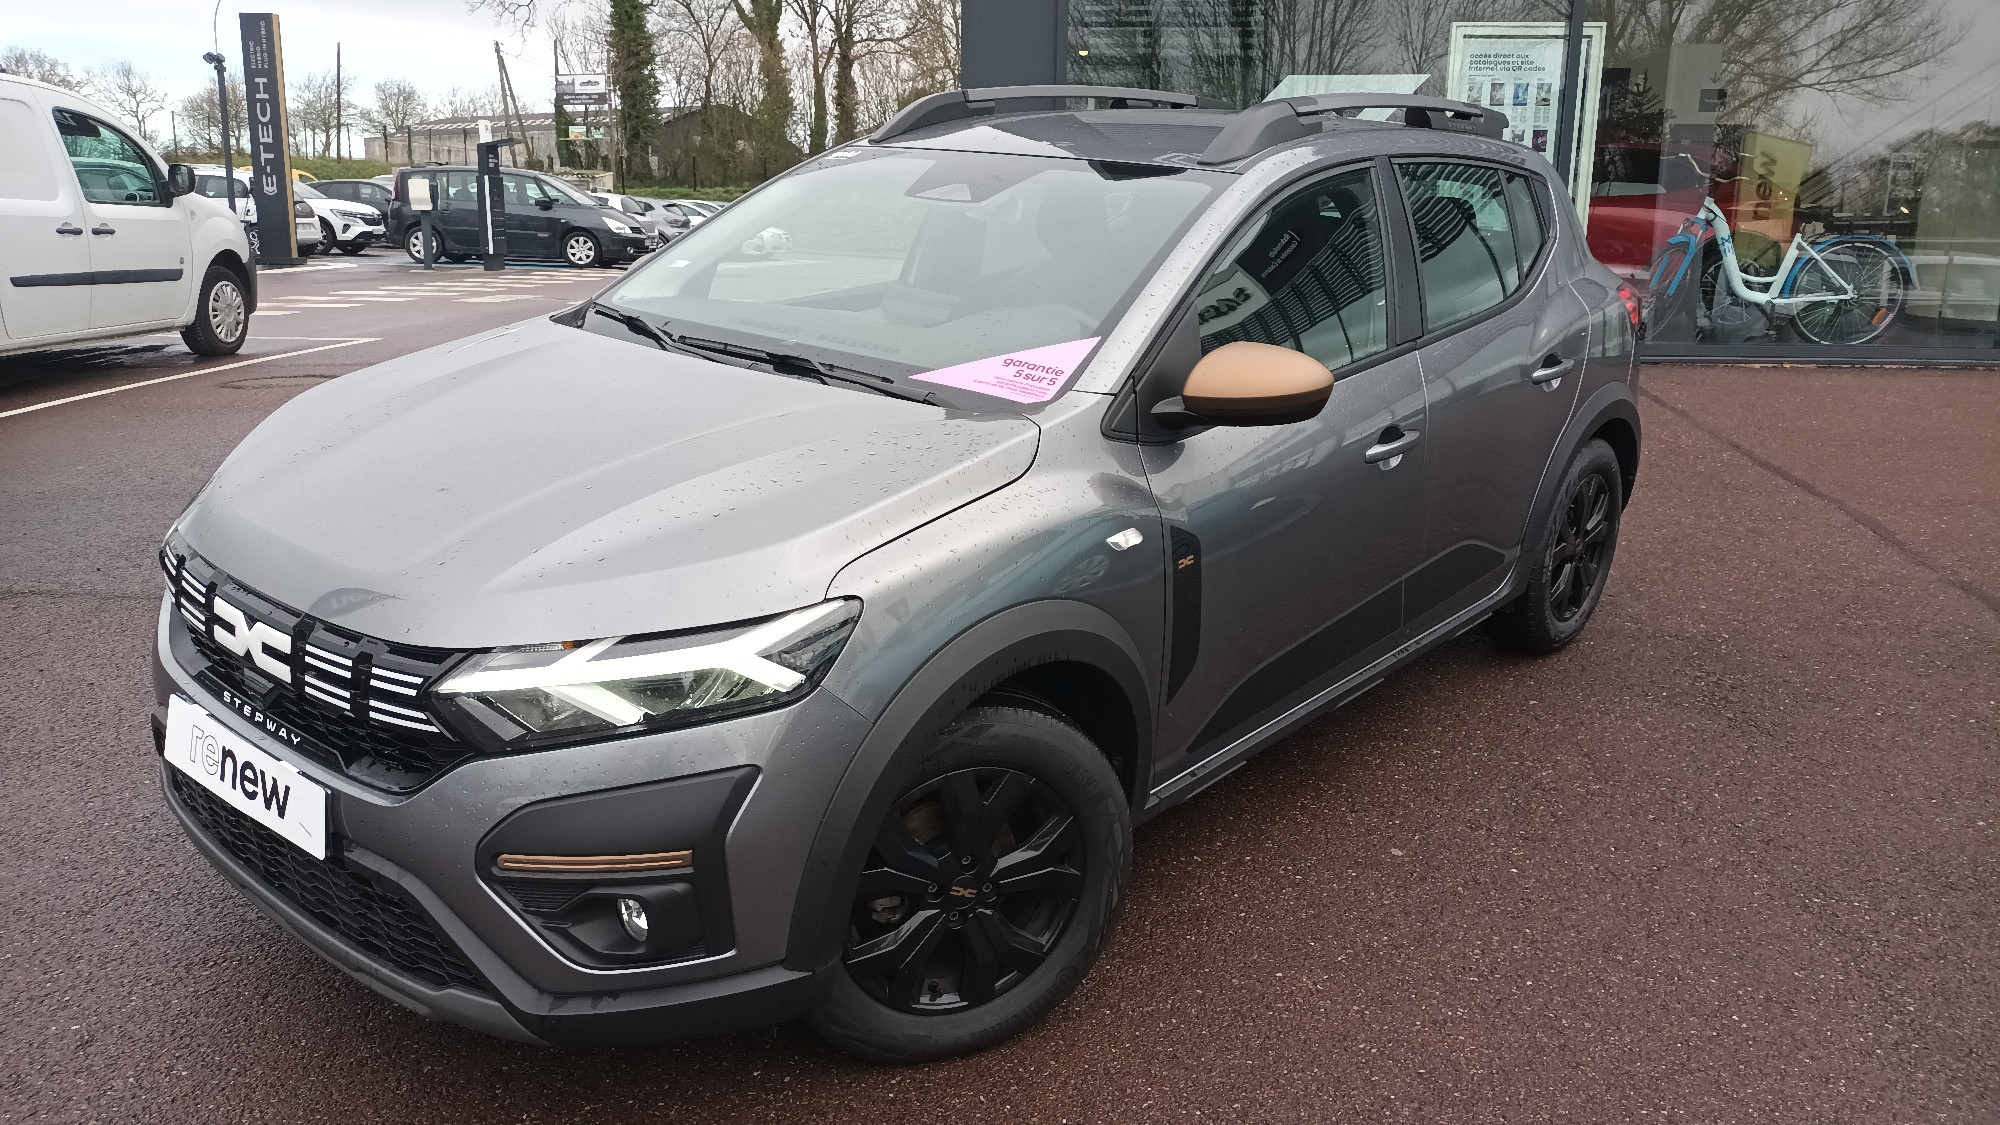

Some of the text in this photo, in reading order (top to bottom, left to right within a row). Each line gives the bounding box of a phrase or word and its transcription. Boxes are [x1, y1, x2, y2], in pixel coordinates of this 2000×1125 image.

[1492, 52, 1515, 60] direct
[1520, 58, 1534, 66] site
[255, 78, 277, 196] E-TECH
[1001, 358, 1065, 377] garantie
[1013, 369, 1059, 386] 5 sur 5
[223, 690, 301, 745] STEPWAY
[189, 724, 291, 820] renew
